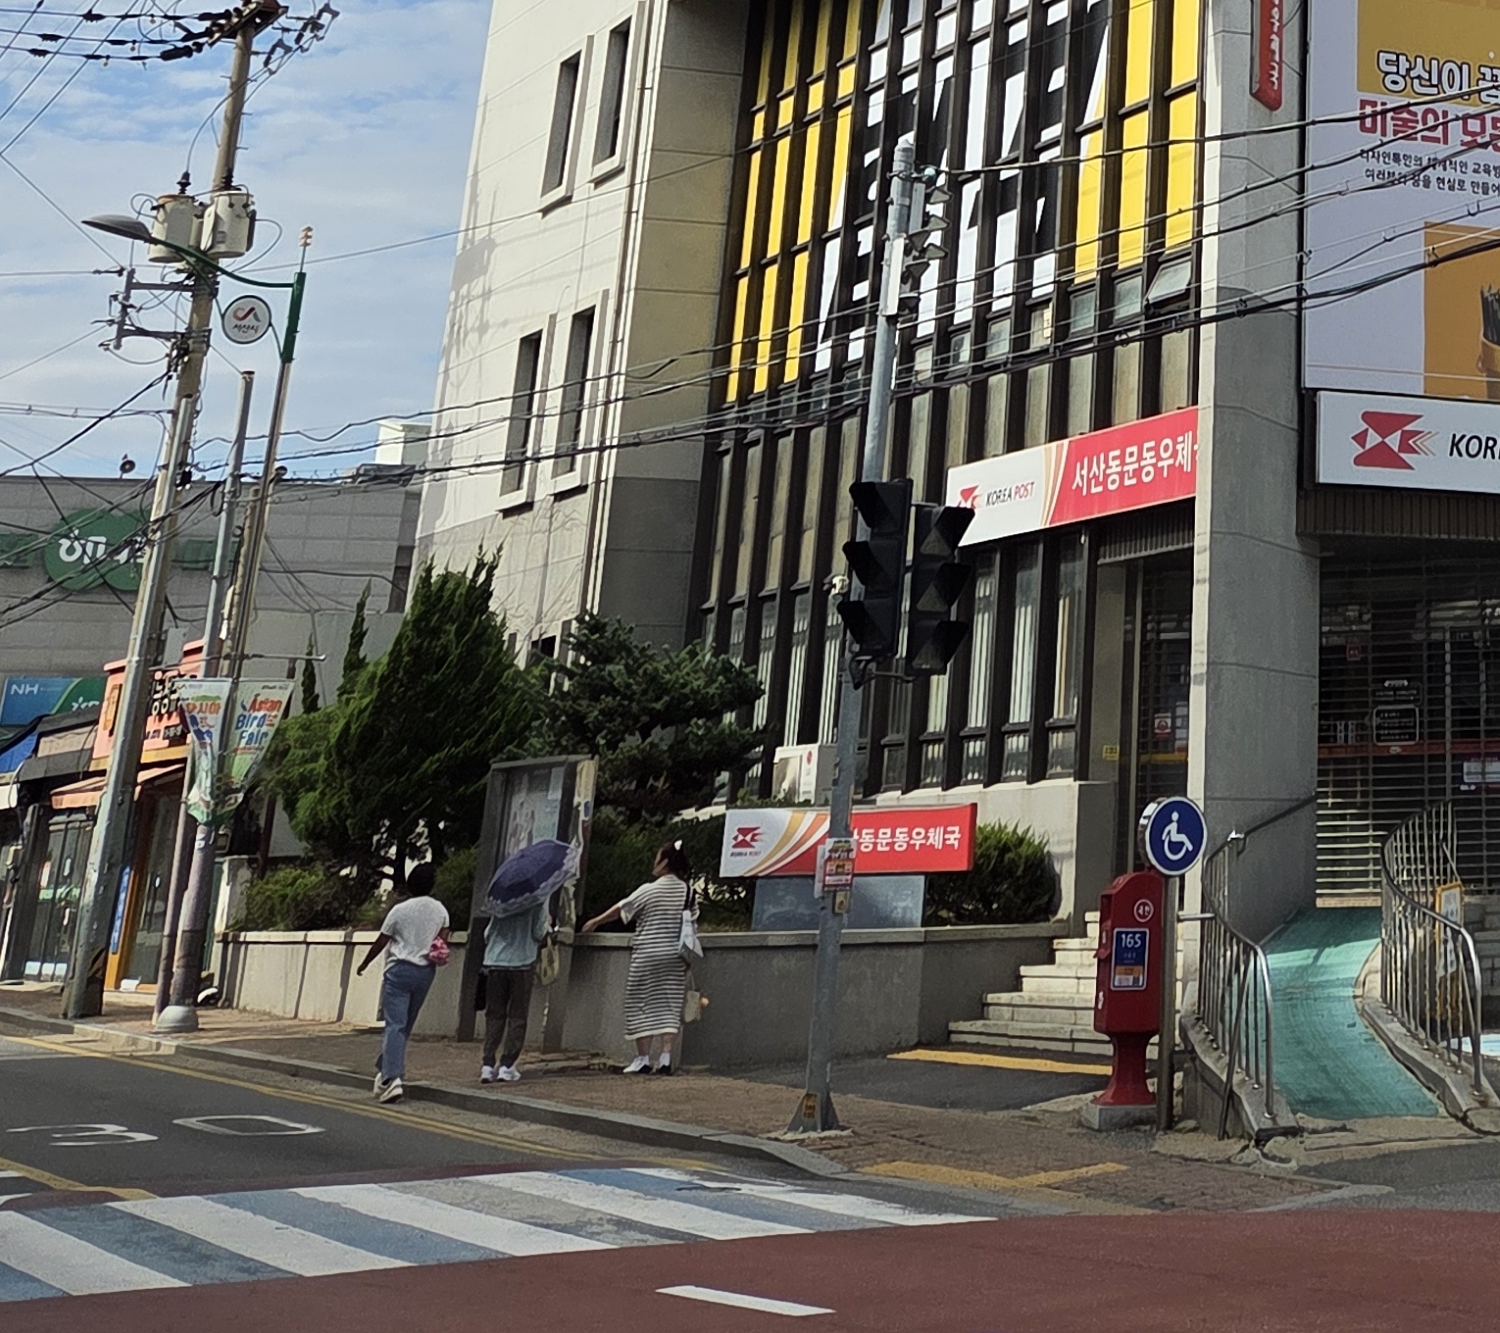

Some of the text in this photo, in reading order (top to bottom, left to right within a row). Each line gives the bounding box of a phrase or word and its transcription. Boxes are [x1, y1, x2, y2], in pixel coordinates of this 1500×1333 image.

[1378, 50, 1470, 99] 당신이
[1359, 99, 1449, 145] 미술의
[1072, 430, 1199, 497] 서산동문동우체
[986, 481, 1035, 507] KOREA POST
[10, 684, 39, 695] NH
[236, 713, 267, 730] Bird
[239, 730, 269, 746] Fair
[1121, 934, 1142, 948] 165
